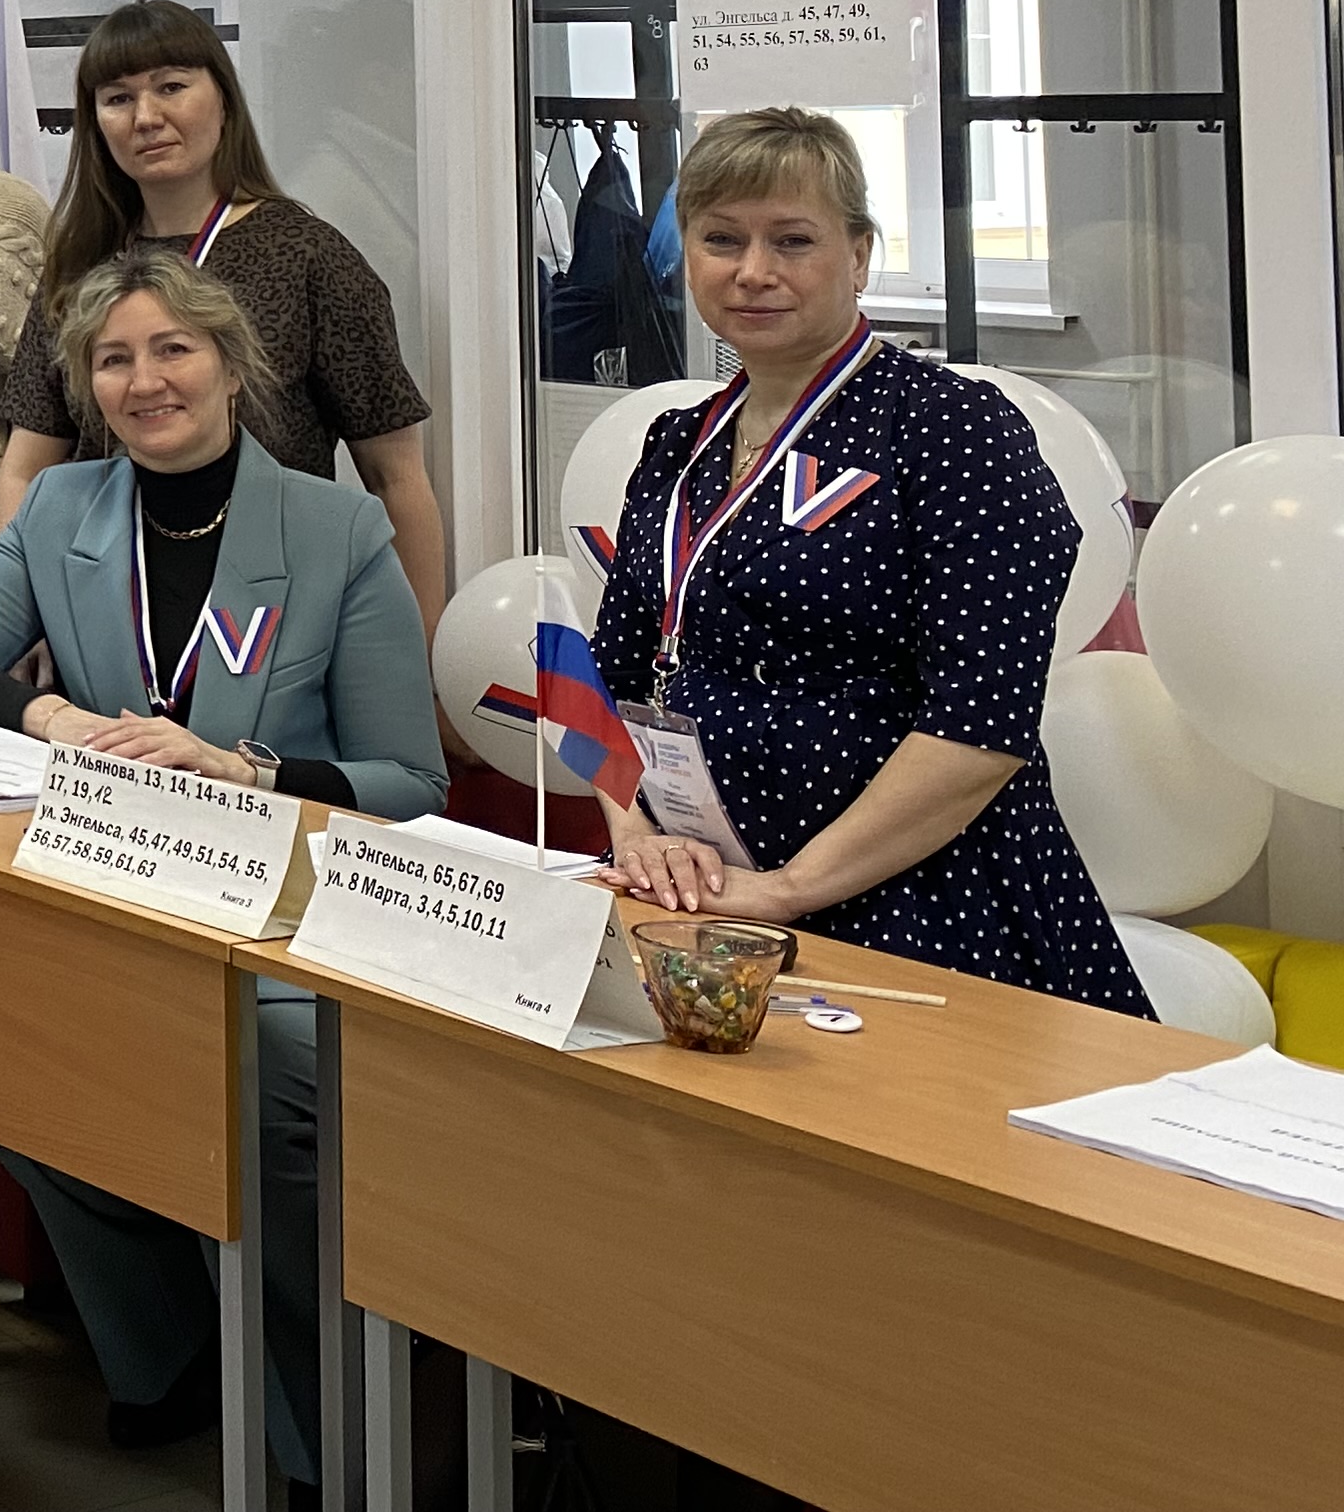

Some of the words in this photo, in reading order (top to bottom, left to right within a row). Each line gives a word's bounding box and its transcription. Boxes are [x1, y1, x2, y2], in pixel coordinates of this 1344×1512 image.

[692, 15, 710, 27] ул.
[715, 10, 778, 24] Энгельса
[799, 6, 820, 22] 45,
[823, 4, 845, 20] 47,
[849, 3, 870, 19] 49,
[692, 35, 713, 49] 51,
[716, 33, 736, 49] 54,
[739, 32, 761, 48] 55,
[764, 31, 785, 47] 56,
[789, 30, 810, 46] 57,
[813, 28, 835, 44] 58,
[839, 27, 860, 43] 59,
[863, 26, 886, 42] 61,
[693, 57, 709, 72] 63
[48, 773, 67, 797] 17,
[52, 747, 69, 764] ул.
[73, 749, 139, 785] Ульянова,
[144, 768, 165, 793] 13,
[170, 775, 191, 800] 14,
[196, 782, 231, 810] 14-а,
[235, 792, 272, 821] 15-а,
[39, 803, 57, 820] ул.
[60, 807, 124, 841] Энгельса,
[244, 859, 268, 884] 55,
[332, 837, 351, 856] ул.
[356, 841, 428, 884] Энгельса,
[433, 864, 505, 903] 65,67,69
[219, 890, 245, 906] Книга
[245, 898, 253, 908] 3
[324, 869, 344, 887] ул.
[348, 872, 359, 891] 8
[361, 876, 413, 914] Марта,
[416, 895, 507, 940] 3,4,5,10,11
[515, 993, 542, 1012] Книга
[544, 1004, 552, 1015] 4
